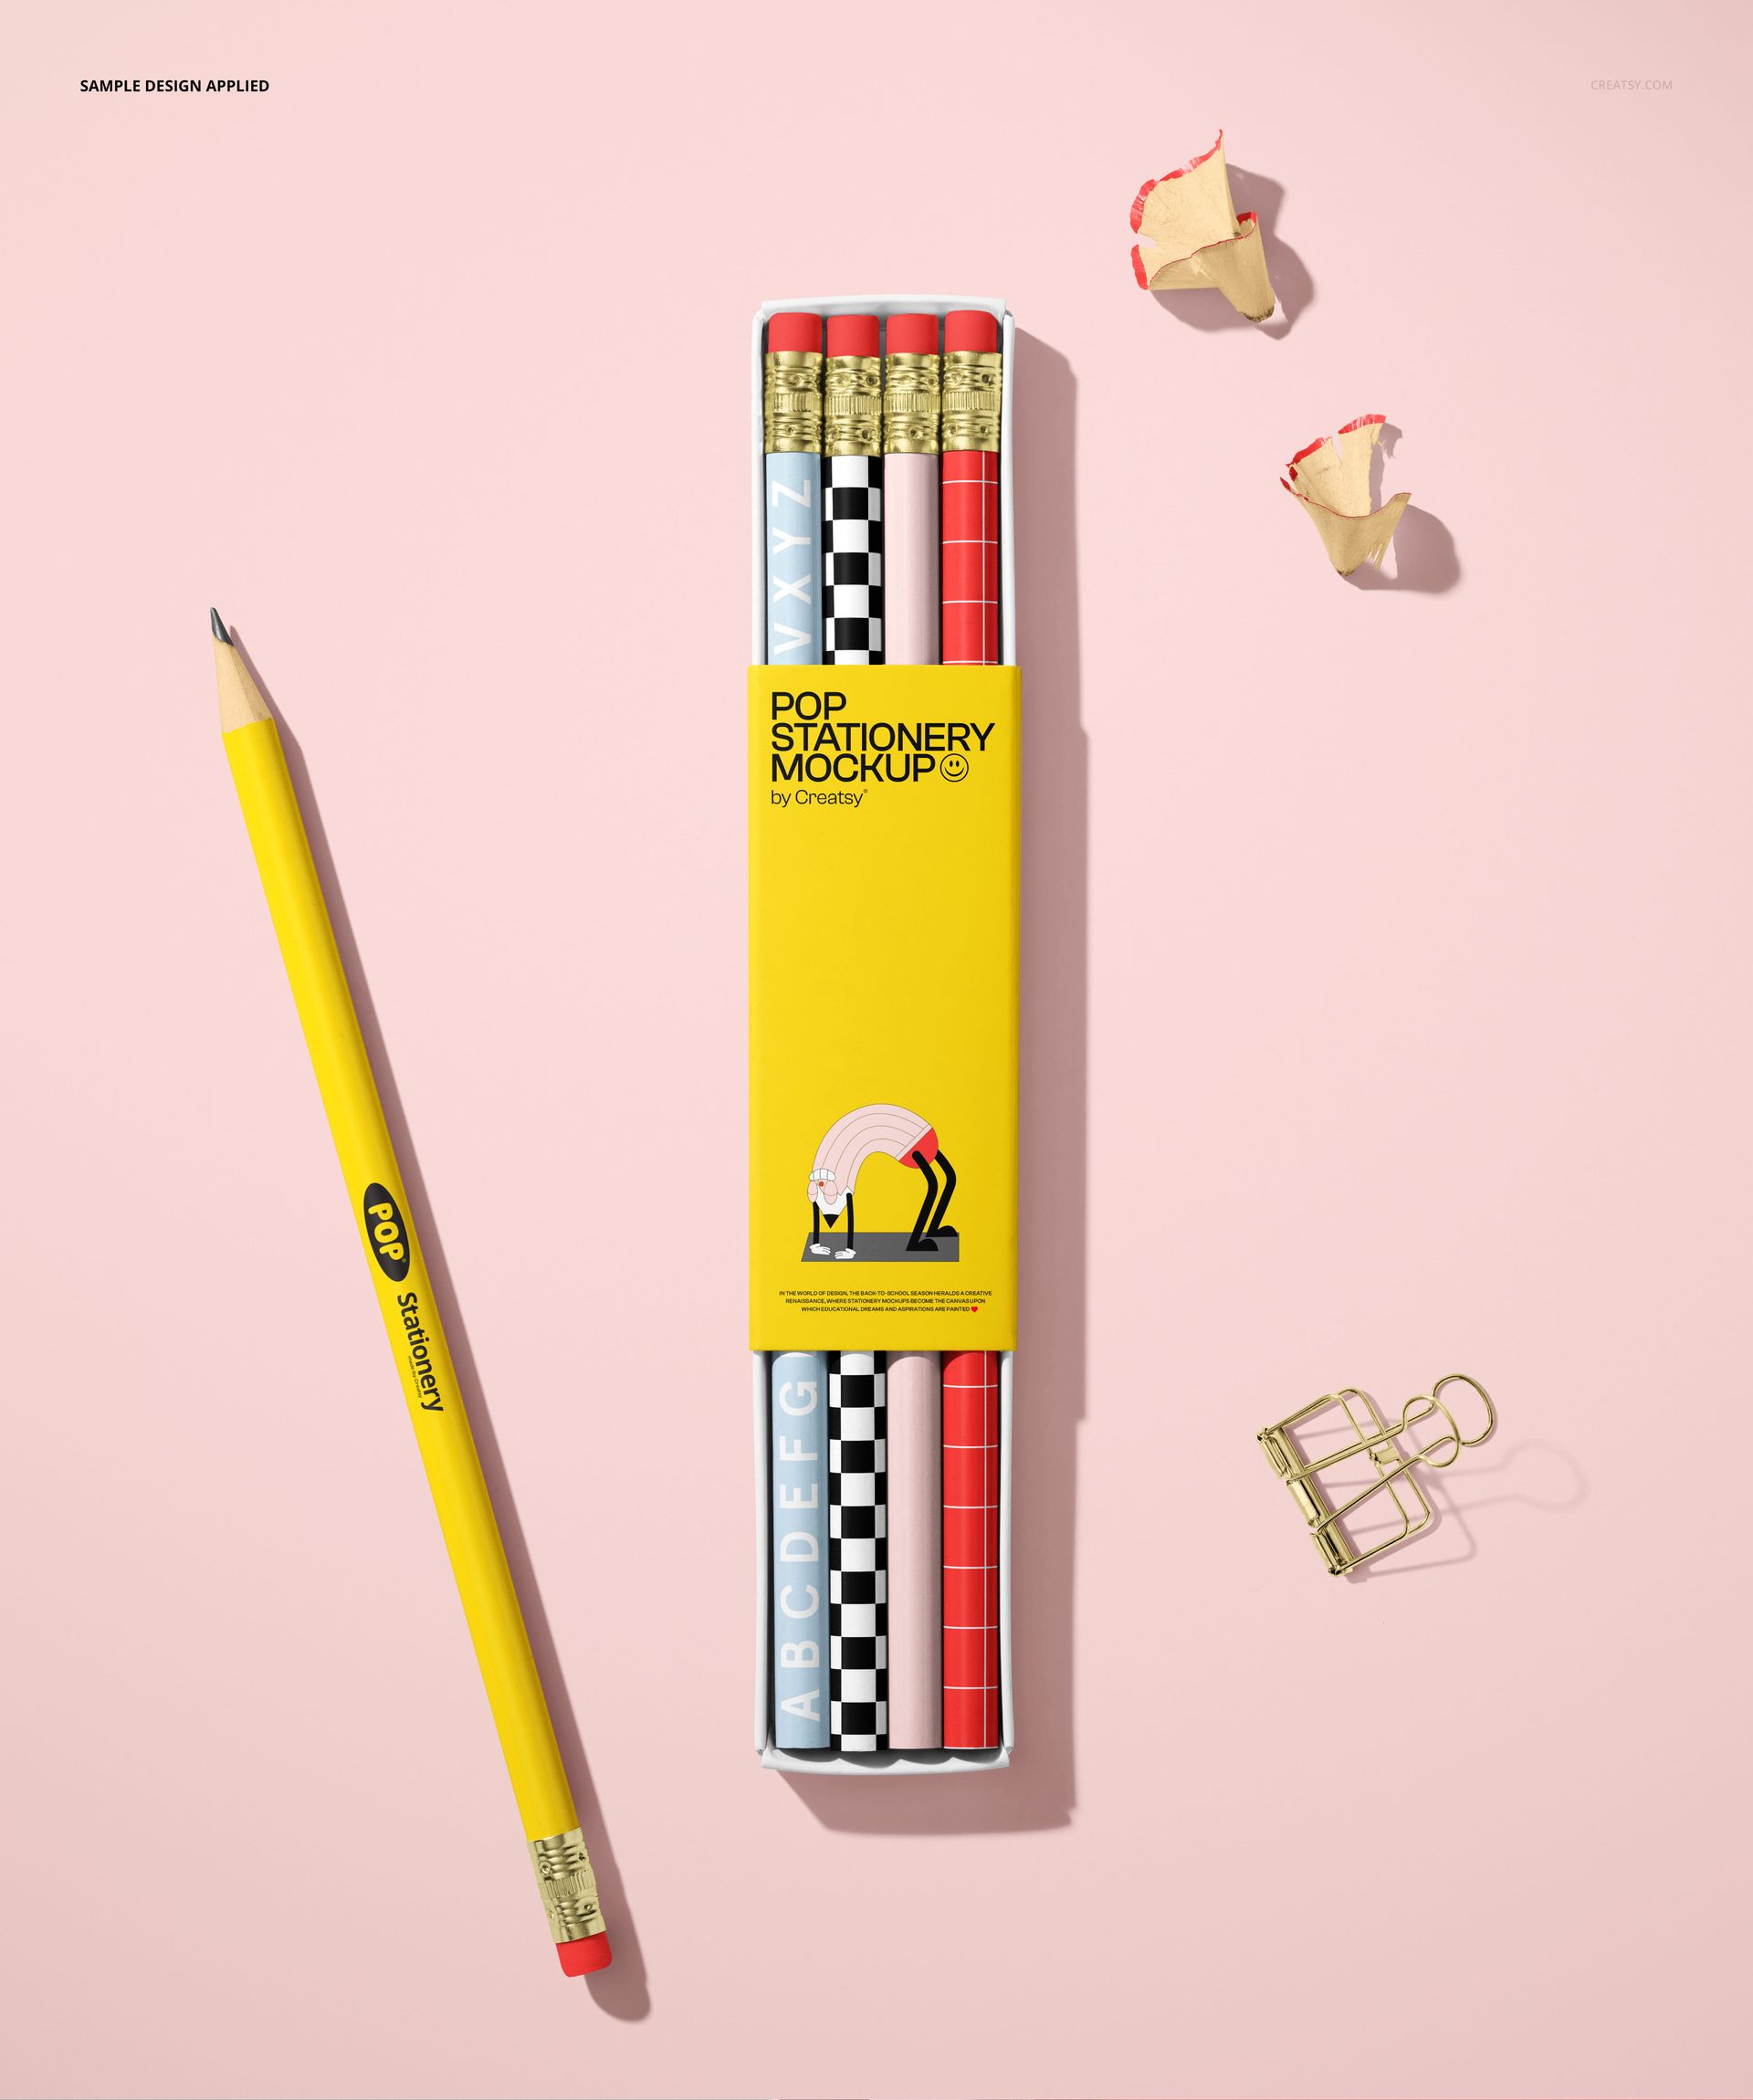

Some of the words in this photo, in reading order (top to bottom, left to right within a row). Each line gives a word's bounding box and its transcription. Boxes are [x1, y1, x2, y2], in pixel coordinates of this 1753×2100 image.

[772, 691, 847, 720] POP
[772, 722, 996, 752] STATIONERY
[772, 753, 936, 783] MOCKUP
[772, 789, 792, 808] by
[397, 1292, 444, 1412] Stationery
